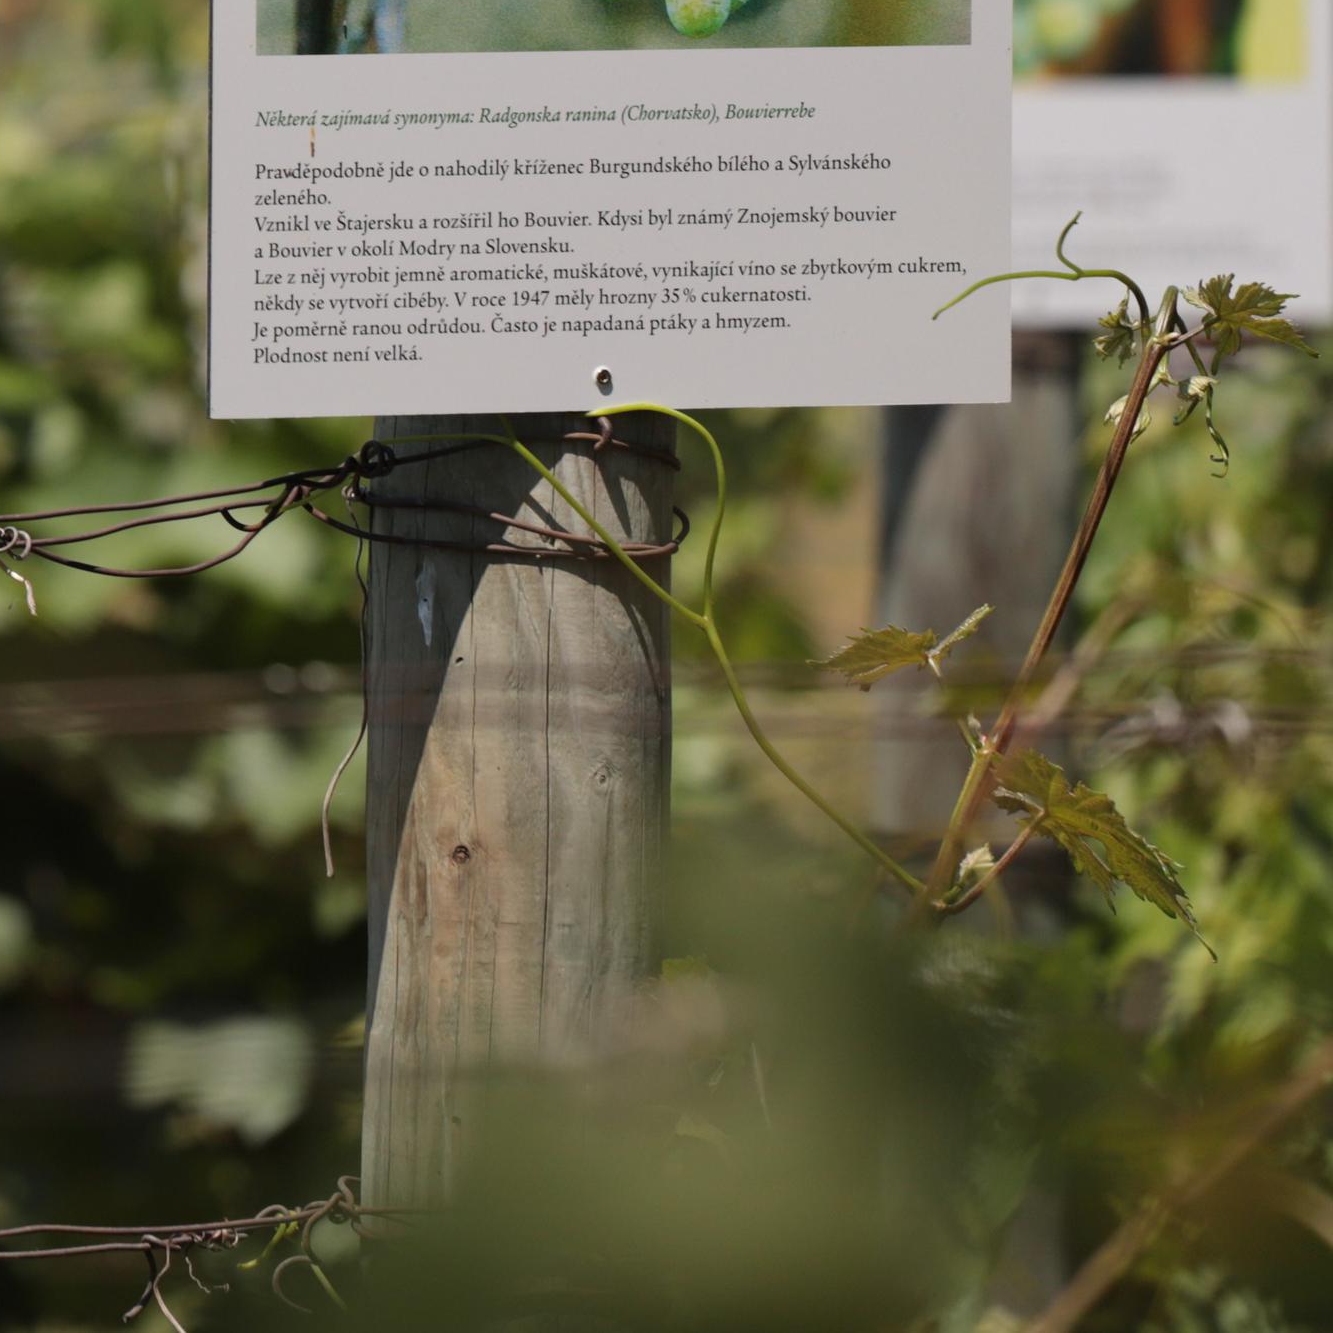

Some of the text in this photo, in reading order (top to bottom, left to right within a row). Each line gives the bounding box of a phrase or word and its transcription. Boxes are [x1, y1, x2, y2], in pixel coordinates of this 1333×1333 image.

[254, 101, 816, 132] Některá zajímavá synonyma: Radgonska ranina (Chorvatsko), Bouvierrebe
[254, 152, 892, 185] Pravděpodobně jde o nahodilý kříženec Burgundského bílého a Sylvánského
[254, 187, 332, 207] zeleného.
[253, 205, 898, 237] Vznikl ve Štajersku a rozšířil ho Bouvier. Kdysi byl známý Znojemský bouvier
[253, 235, 575, 262] a Bouvier v okolí Modry na Slovensku.
[254, 255, 967, 290] Lze z něj vyrobit jemně aromatické, muškátové, vynikající víno se zbytkovým cukrem,
[253, 293, 305, 317] někdy
[307, 298, 326, 311] se
[328, 292, 390, 316] vytvoří
[392, 290, 450, 314] cibéby.
[453, 291, 468, 308] V
[471, 295, 507, 309] roce
[512, 289, 551, 307] 1947
[554, 287, 595, 311] měly
[598, 287, 658, 310] hrozny
[700, 284, 812, 305] cukernatosti.
[250, 311, 792, 344] Je poměrně ranou odrůdou. Často je napadaná ptáky a hmyzem.
[253, 343, 423, 364] Plodnost není velká.
